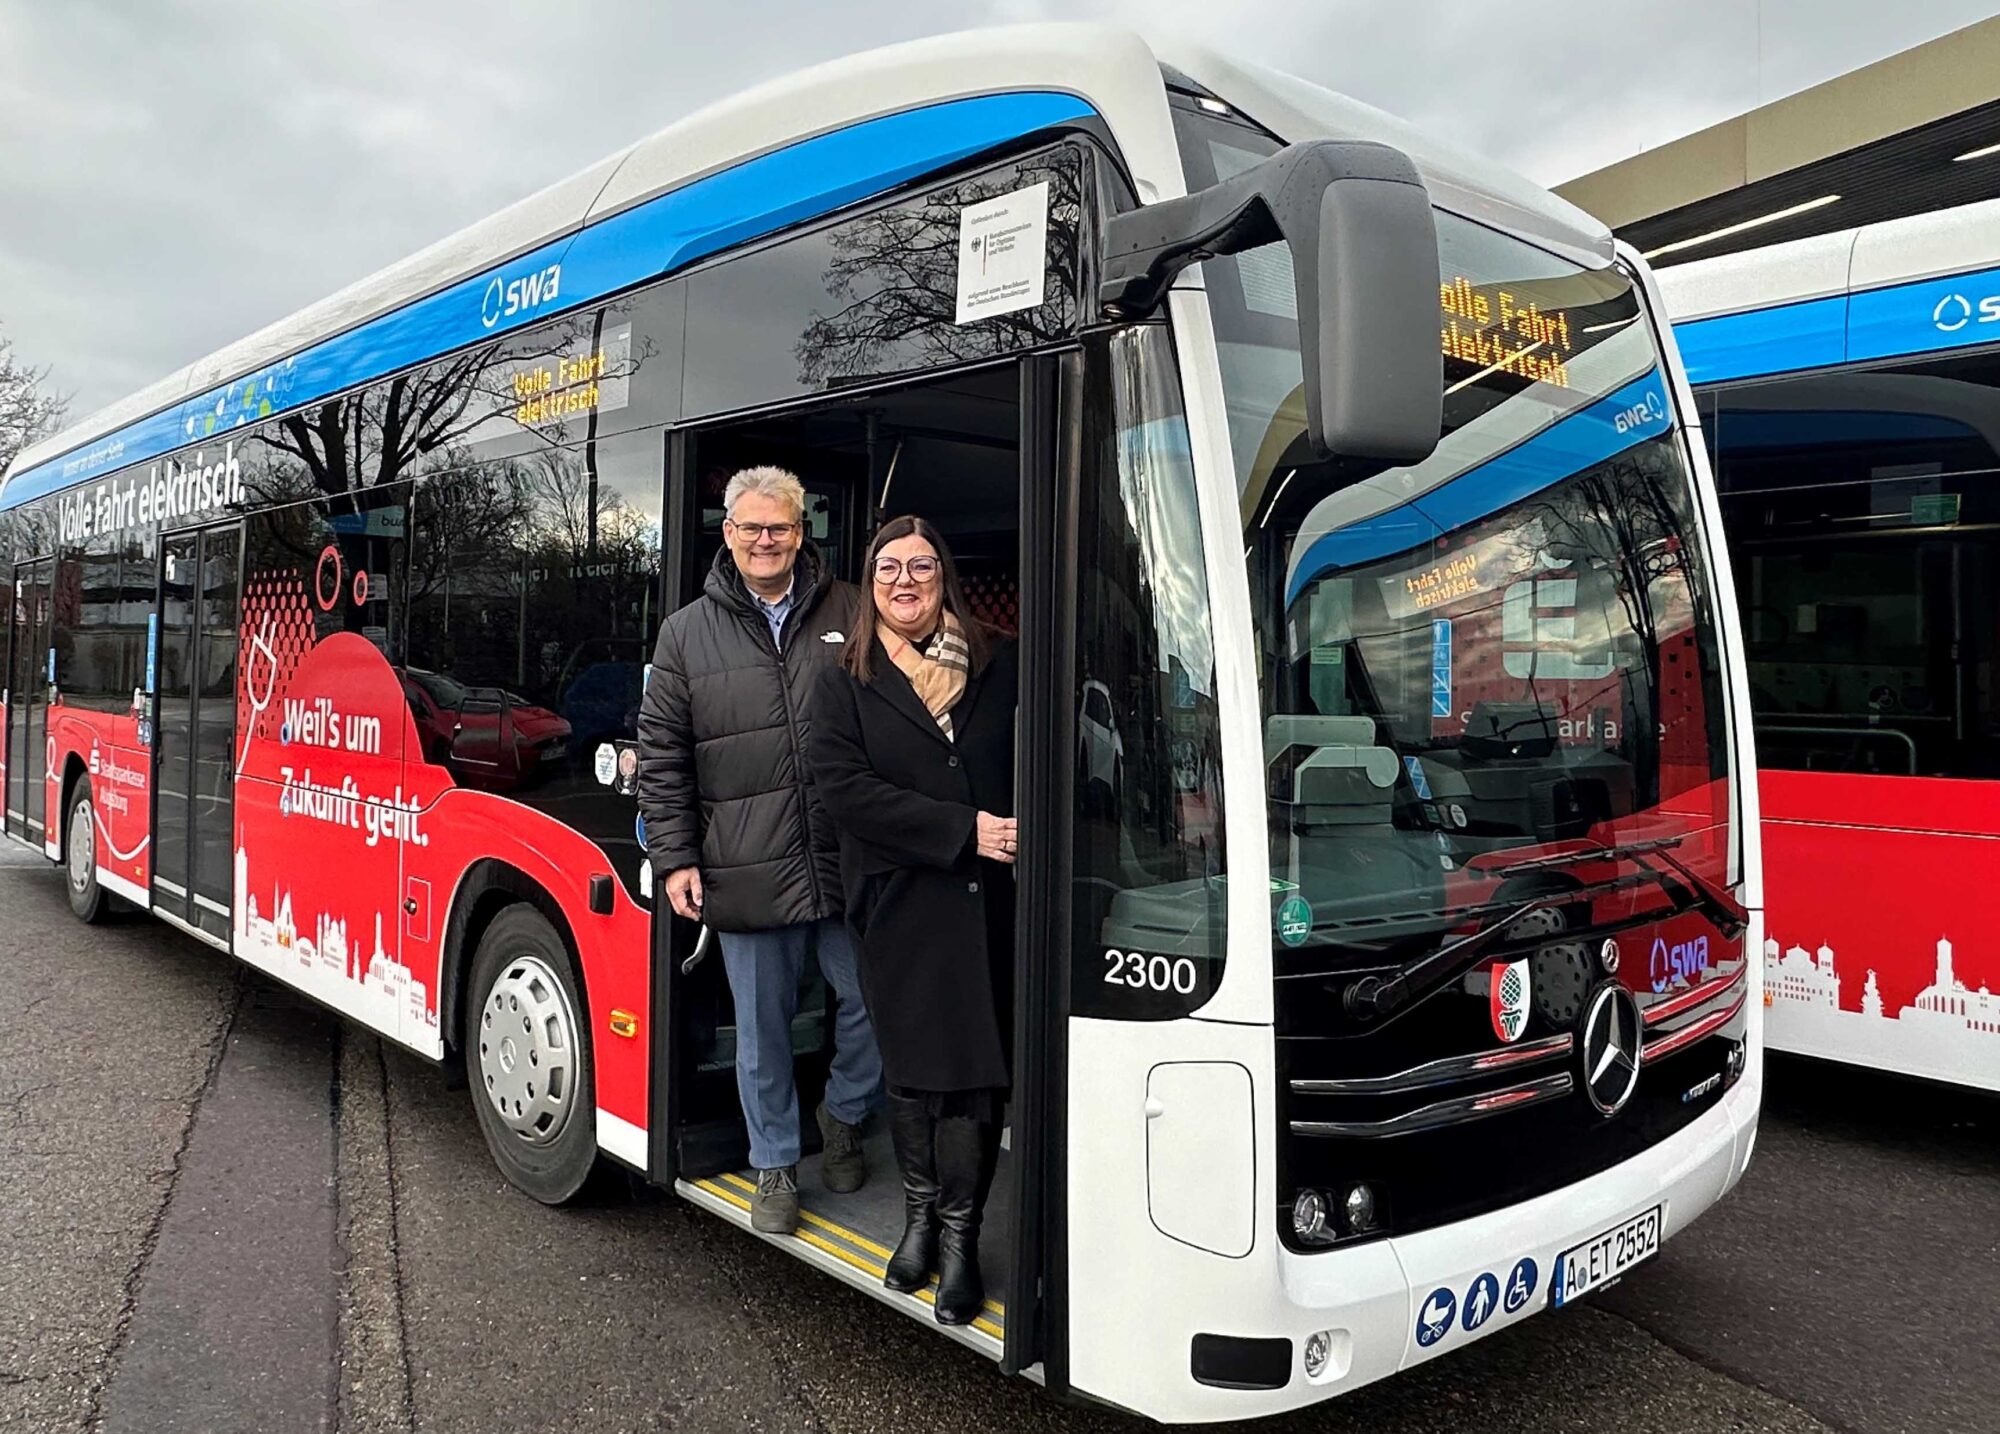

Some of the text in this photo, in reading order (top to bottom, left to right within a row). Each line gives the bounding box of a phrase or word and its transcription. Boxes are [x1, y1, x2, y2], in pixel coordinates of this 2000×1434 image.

[504, 264, 560, 316] swa
[1440, 276, 1570, 351] olle Fahrt
[514, 347, 605, 396] Volle Fahrt
[517, 381, 599, 424] elektrisch
[58, 441, 246, 543] Volle Fahrt elektrisch.
[284, 697, 381, 754] Weil's um
[280, 766, 429, 847] Zukunft geht.
[1104, 949, 1196, 994] 2300
[1671, 935, 1708, 983] swa
[1566, 1257, 1577, 1296] A
[1590, 1237, 1611, 1283] ET
[1616, 1215, 1655, 1268] 2552
